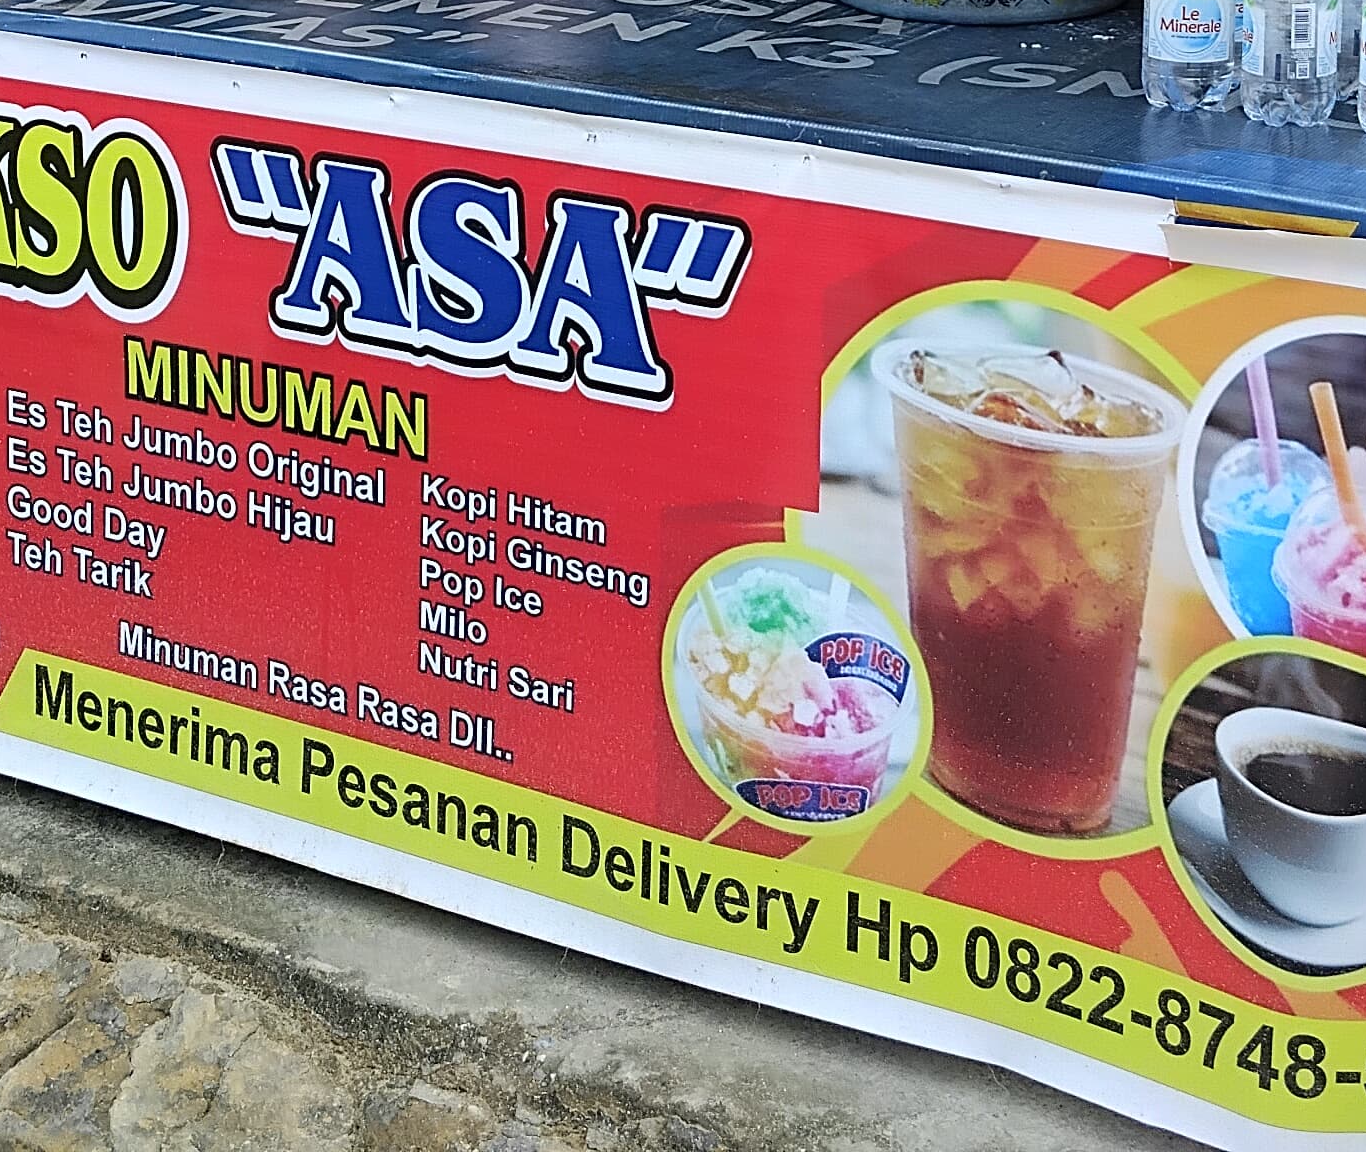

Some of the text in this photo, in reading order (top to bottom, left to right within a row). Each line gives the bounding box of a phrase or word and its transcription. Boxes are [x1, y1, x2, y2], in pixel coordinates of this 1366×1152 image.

[1159, 18, 1222, 35] Minerale
[1181, 5, 1200, 22] Le
[697, 29, 900, 70] K3
[125, 336, 428, 460] MINUMAN
[7, 389, 386, 505] Es Teh Jumbo Original
[6, 485, 166, 560] Good Day
[7, 437, 335, 545] Es Teh Jumbo Hijau
[421, 474, 607, 545] Kopi Hitam
[6, 531, 153, 598] Teh Tarik
[419, 559, 543, 615] Pop Ice
[421, 517, 650, 606] Kopi Ginseng
[419, 601, 488, 646] Milo
[119, 620, 258, 691] Minuman
[269, 666, 348, 716] Rasa
[356, 684, 439, 736] Rasa
[419, 647, 574, 712] Nutri Sari
[34, 664, 281, 786] Menerima
[299, 738, 539, 863] Pesanan
[560, 816, 820, 954] Delivery
[845, 889, 940, 984] Hp
